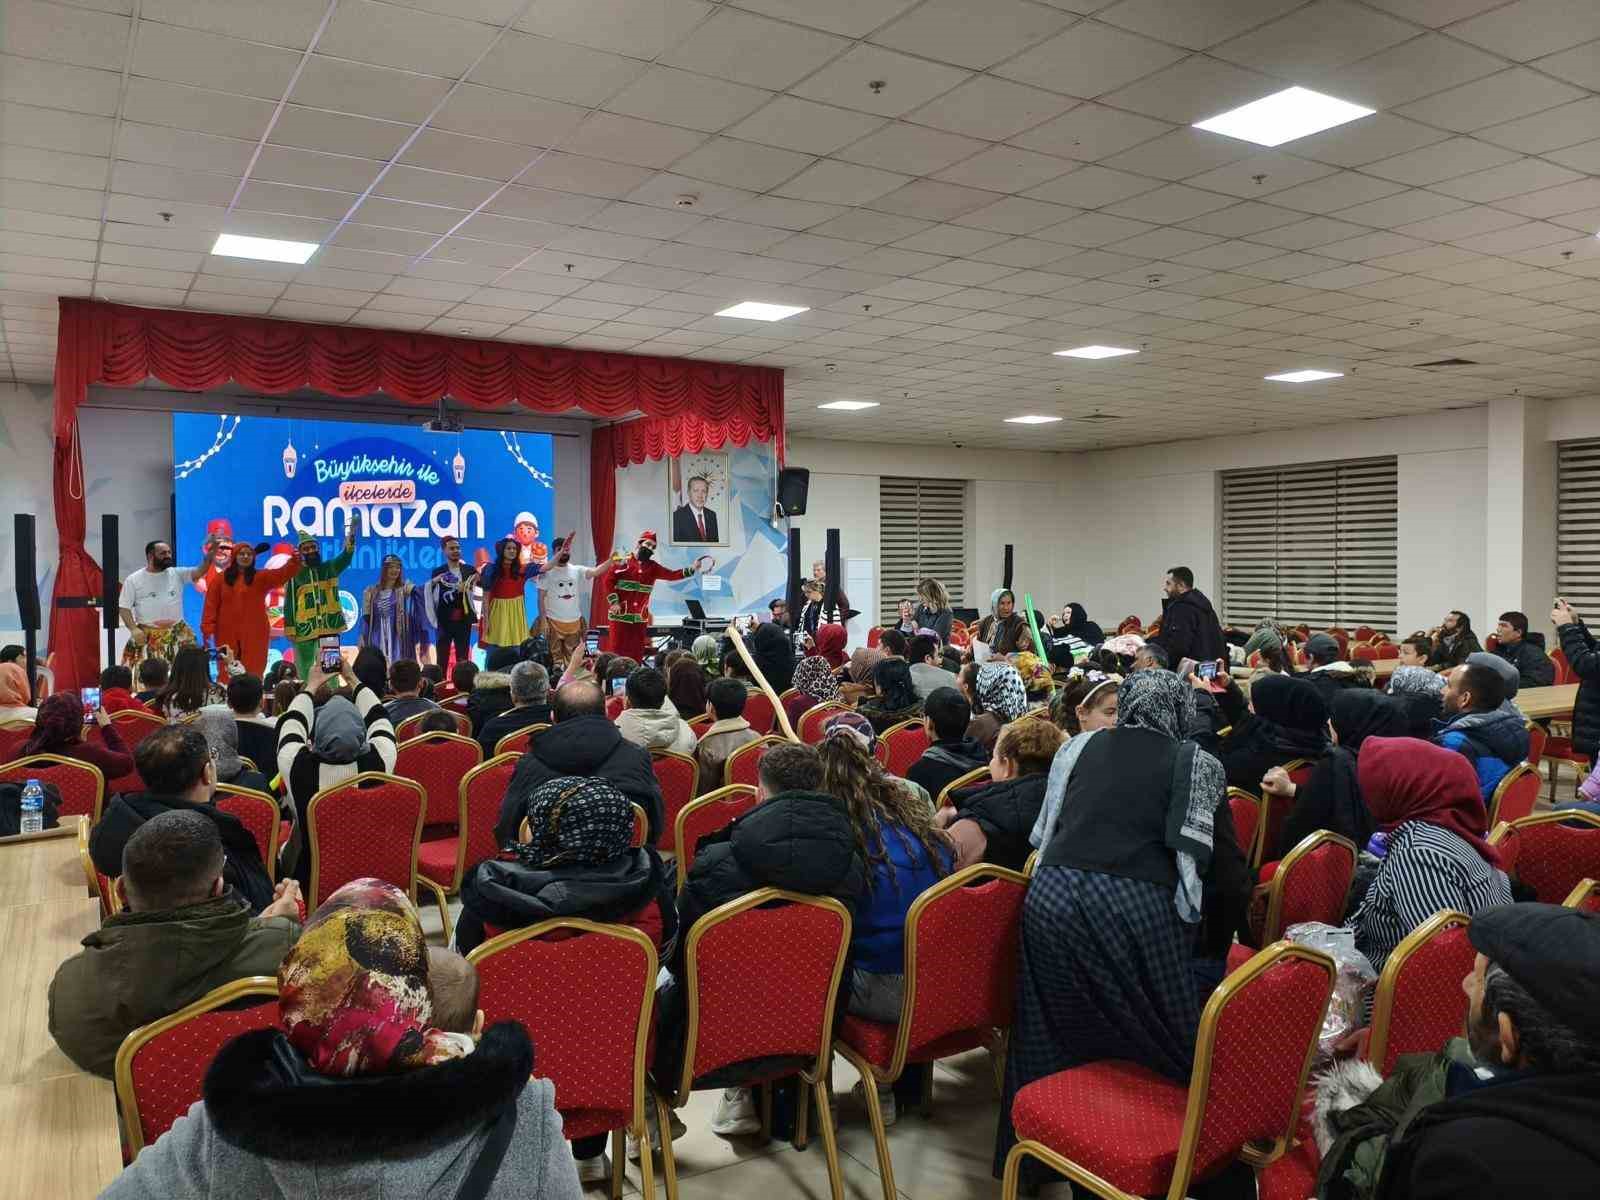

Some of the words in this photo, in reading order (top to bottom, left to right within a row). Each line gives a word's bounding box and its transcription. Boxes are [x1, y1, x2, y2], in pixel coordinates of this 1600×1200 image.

[314, 454, 415, 483] Büyükşehir
[417, 464, 440, 485] ile
[343, 482, 413, 503] ilçelerde
[263, 495, 486, 538] Ramazan
